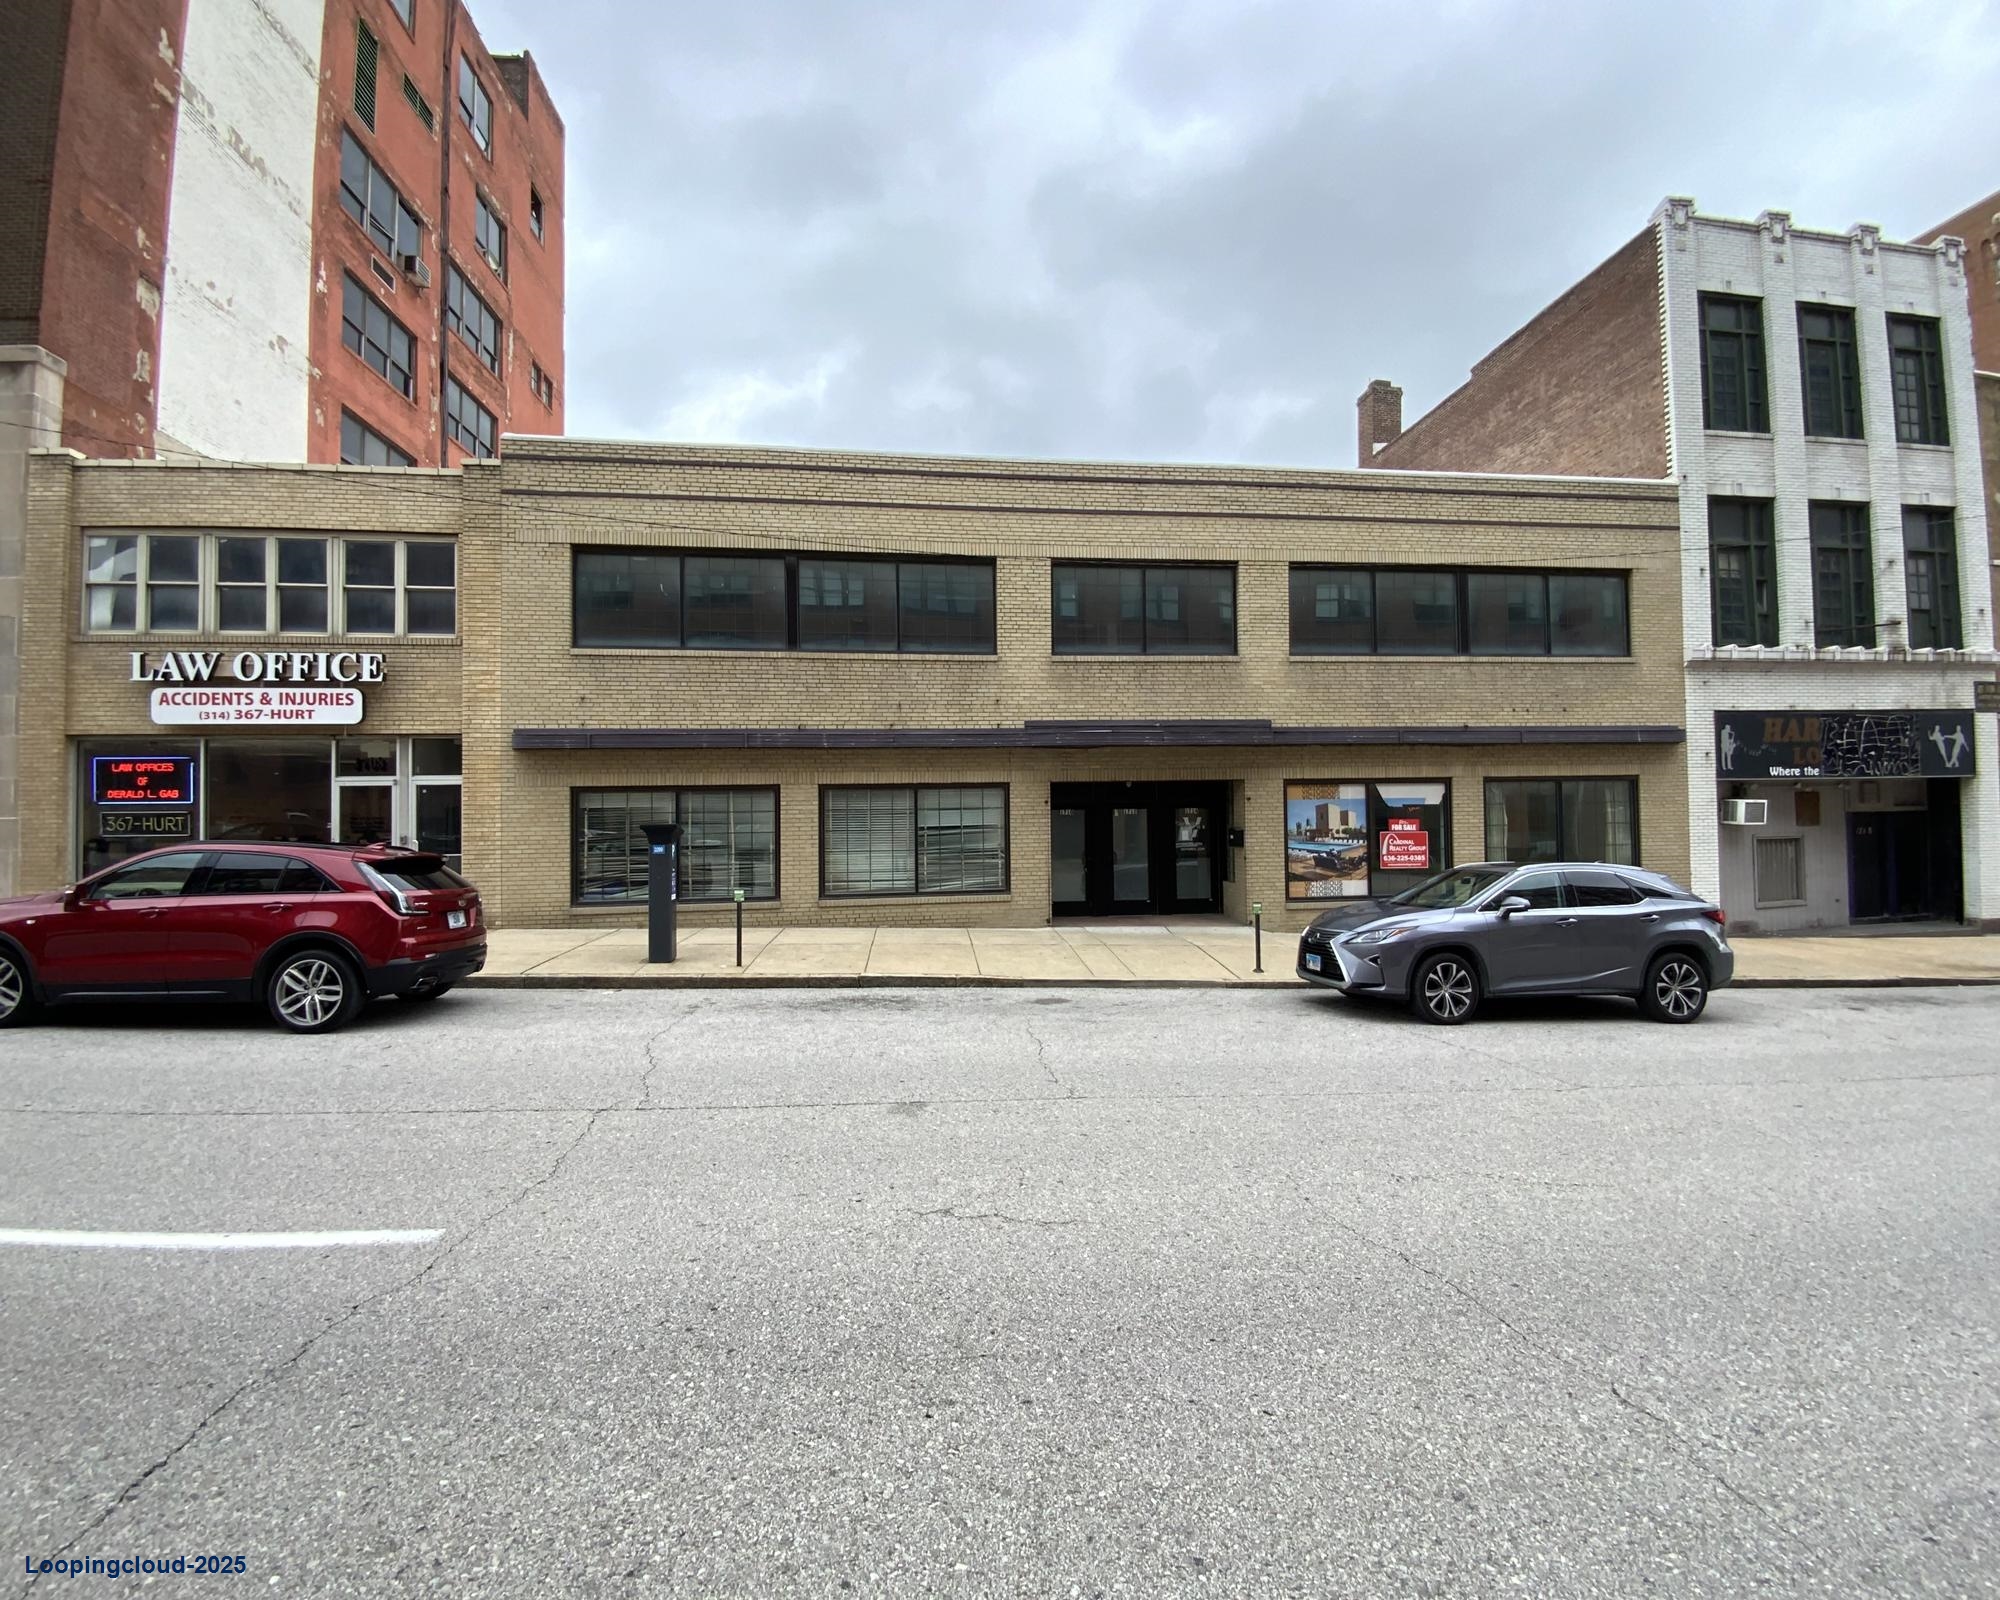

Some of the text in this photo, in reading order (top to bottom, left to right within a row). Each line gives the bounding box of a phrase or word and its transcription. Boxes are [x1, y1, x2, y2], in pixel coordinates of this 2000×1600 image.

[129, 651, 385, 683] LAW OFFICE
[159, 691, 354, 706] ACCIDENTS & INJURIES
[199, 709, 315, 721] (314) 367-HURT
[111, 763, 175, 772] LAW OFFICES
[1769, 766, 1820, 776] Where the
[137, 776, 149, 786] OF
[105, 816, 185, 831] 367-HURT
